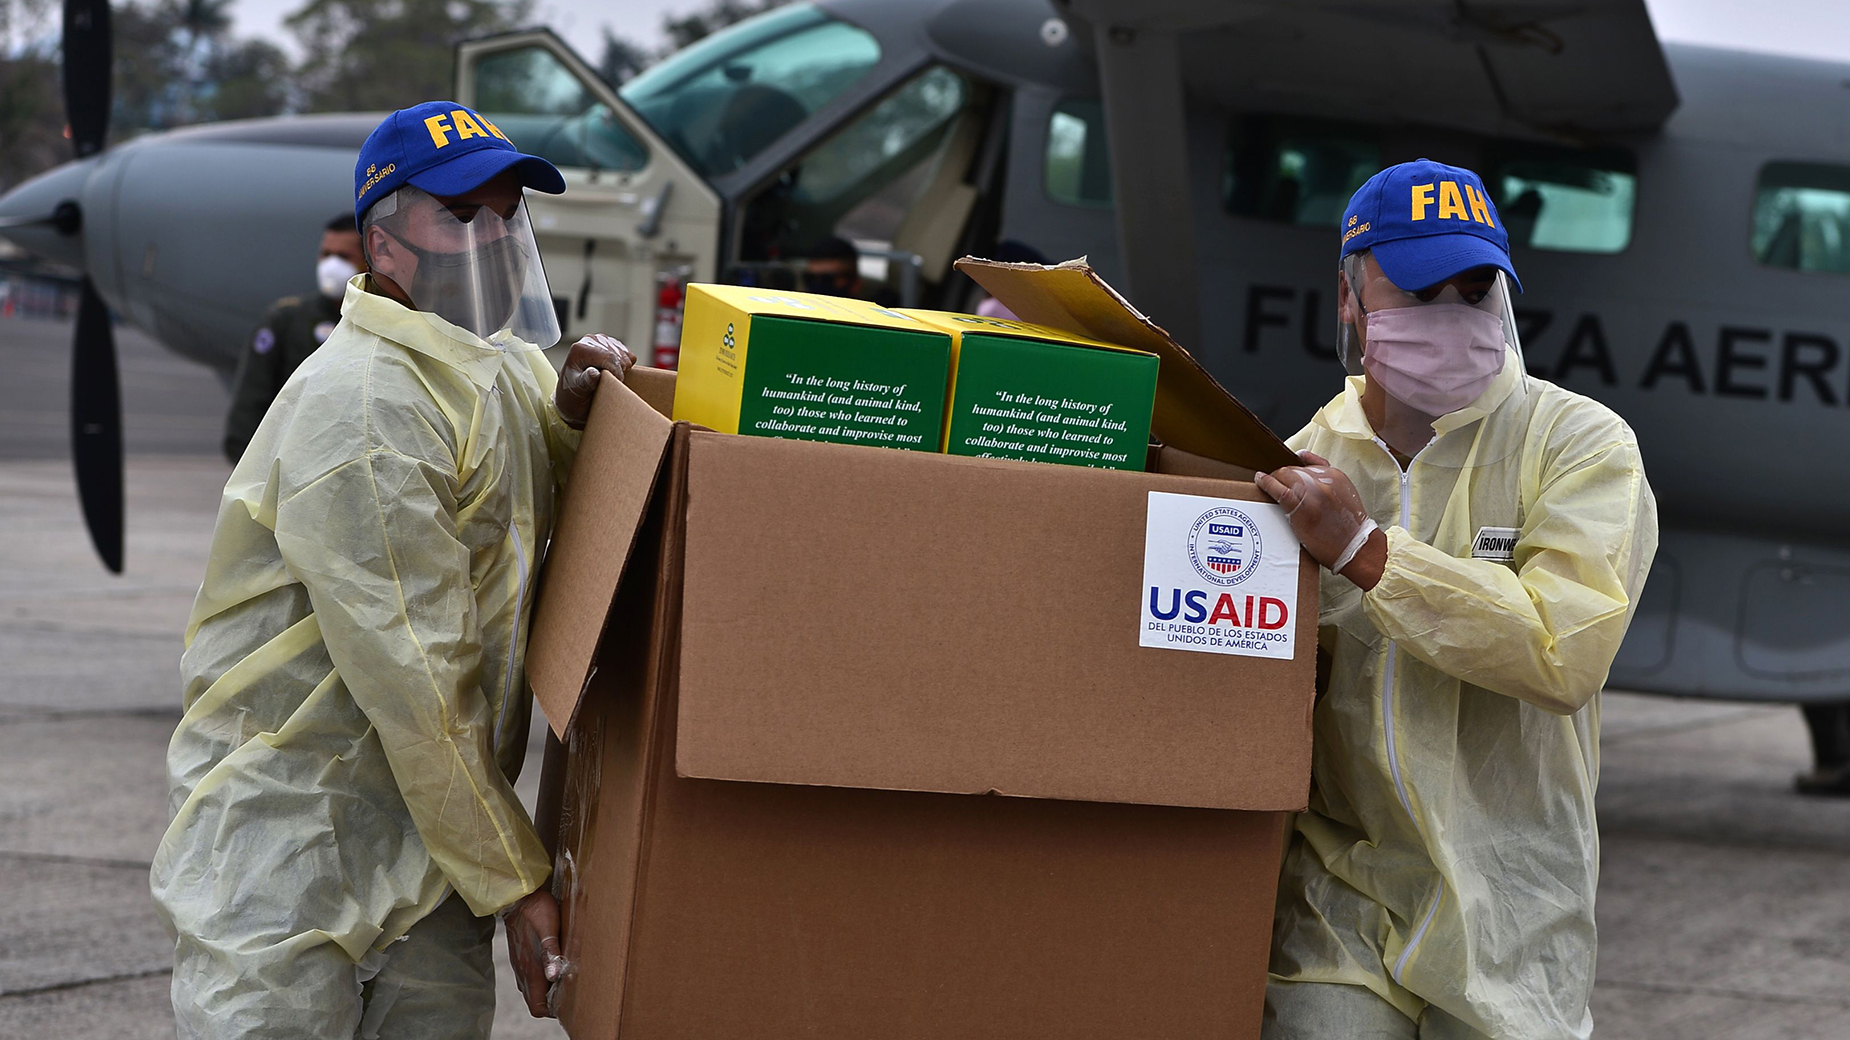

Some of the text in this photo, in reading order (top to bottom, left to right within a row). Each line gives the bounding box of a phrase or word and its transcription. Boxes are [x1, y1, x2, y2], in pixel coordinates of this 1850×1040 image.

[423, 109, 514, 149] FAH
[1411, 181, 1496, 229] FAH
[1245, 284, 1850, 406] FUZA AER
[806, 375, 824, 386] the
[826, 377, 850, 392] long
[853, 380, 890, 395] history
[892, 384, 907, 396] of
[762, 387, 922, 413] humankind (and animal kind,
[1015, 393, 1033, 405] the
[1035, 395, 1059, 410] long
[1061, 398, 1097, 414] history
[1099, 403, 1113, 416] of
[773, 405, 908, 426] too) those who learned to
[972, 404, 1127, 432] humankind (and animal kind,
[755, 420, 816, 433] collaborate
[818, 426, 840, 436] and
[842, 426, 894, 441] improvise
[896, 434, 922, 444] most
[982, 422, 1113, 445] too) those who learned to
[965, 436, 1025, 451] collaborate
[1027, 444, 1048, 454] and
[1049, 445, 1100, 459] improvise
[1102, 452, 1127, 462] most
[1194, 512, 1214, 532] UNITED
[1238, 514, 1259, 537] AGENCY
[1212, 526, 1240, 535] USAID
[1190, 544, 1259, 584] INTERNATIONAL DEVELOPMENT
[1150, 586, 1288, 630] USAID
[1148, 622, 1288, 642] DEL PUEBLO DE LOS ESTADOS
[1167, 634, 1268, 650] UNIDOS DE AMÉRICA
